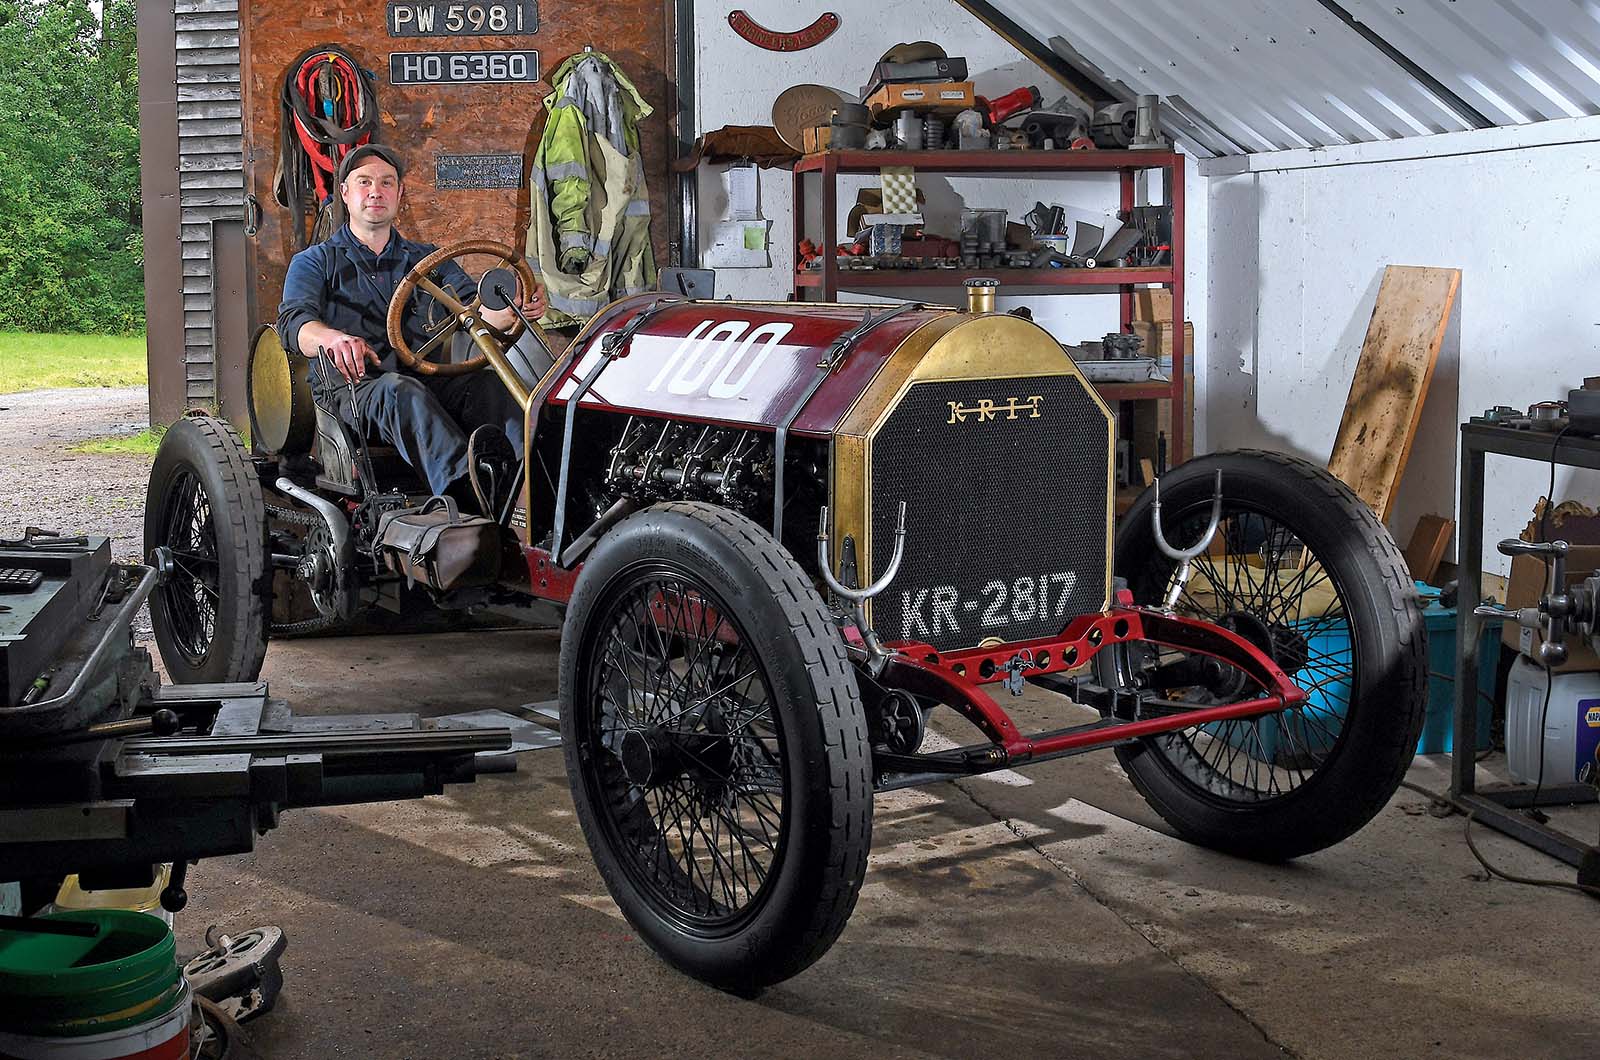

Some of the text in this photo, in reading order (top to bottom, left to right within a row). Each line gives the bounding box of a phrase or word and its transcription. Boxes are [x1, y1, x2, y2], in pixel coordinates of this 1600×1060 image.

[394, 4, 523, 33] PW 5981
[403, 54, 527, 81] HO 6360
[646, 319, 794, 399] 100
[946, 395, 1044, 424] KRIT
[900, 570, 1076, 640] KR-2817
